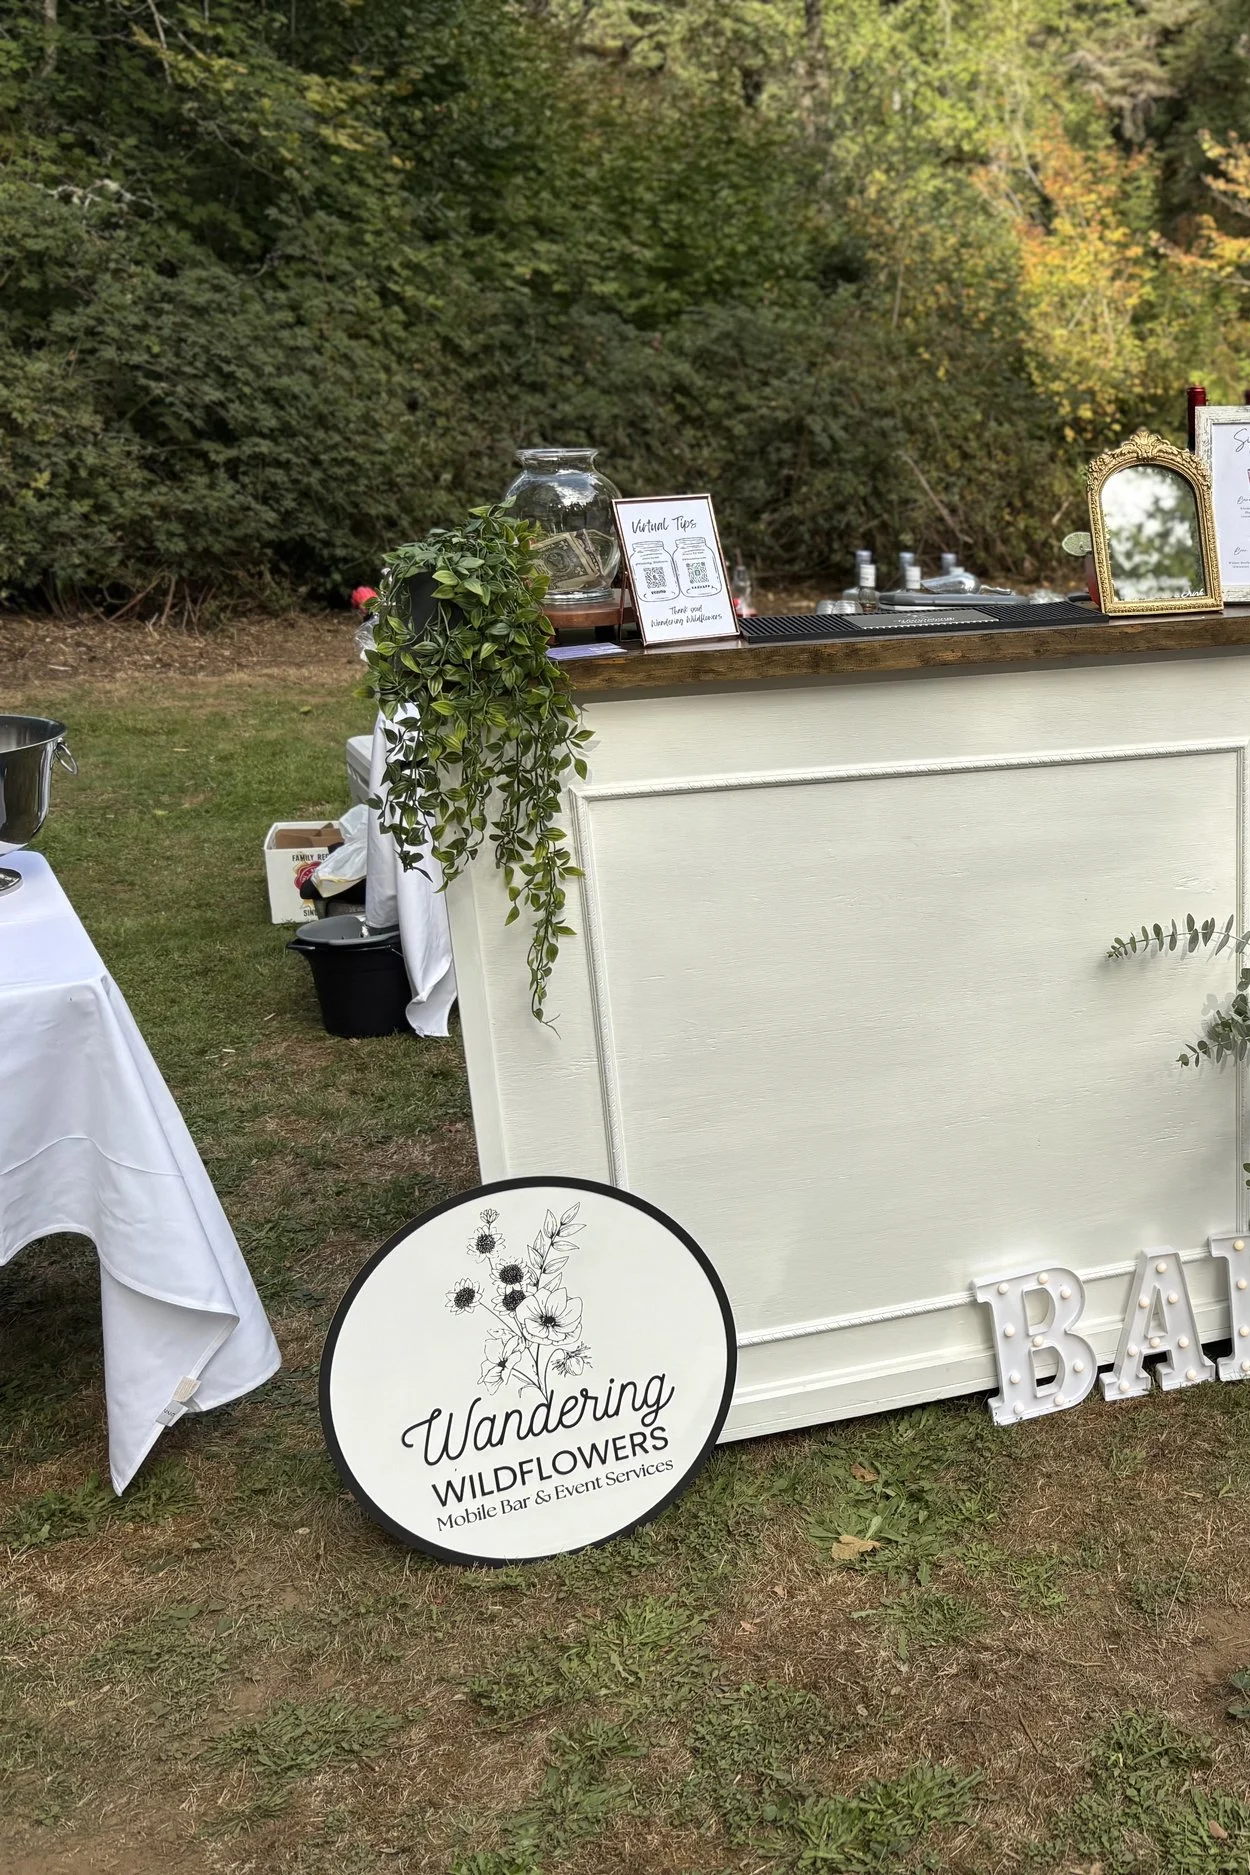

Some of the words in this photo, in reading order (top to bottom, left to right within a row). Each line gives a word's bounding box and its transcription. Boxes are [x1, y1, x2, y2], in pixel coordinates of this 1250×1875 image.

[632, 517, 669, 534] Virtual
[672, 515, 697, 532] Tips
[669, 605, 689, 615] Thank
[651, 616, 684, 628] Wandering
[686, 613, 723, 624] Wildflowers
[292, 853, 314, 862] FAMILY
[400, 1372, 676, 1467] Wandering
[430, 1425, 669, 1508] WILDFLOWERS
[436, 1503, 498, 1532] Mobile
[501, 1493, 531, 1515] Bar
[534, 1489, 552, 1506] &
[554, 1478, 603, 1501] Event
[604, 1458, 674, 1485] Services
